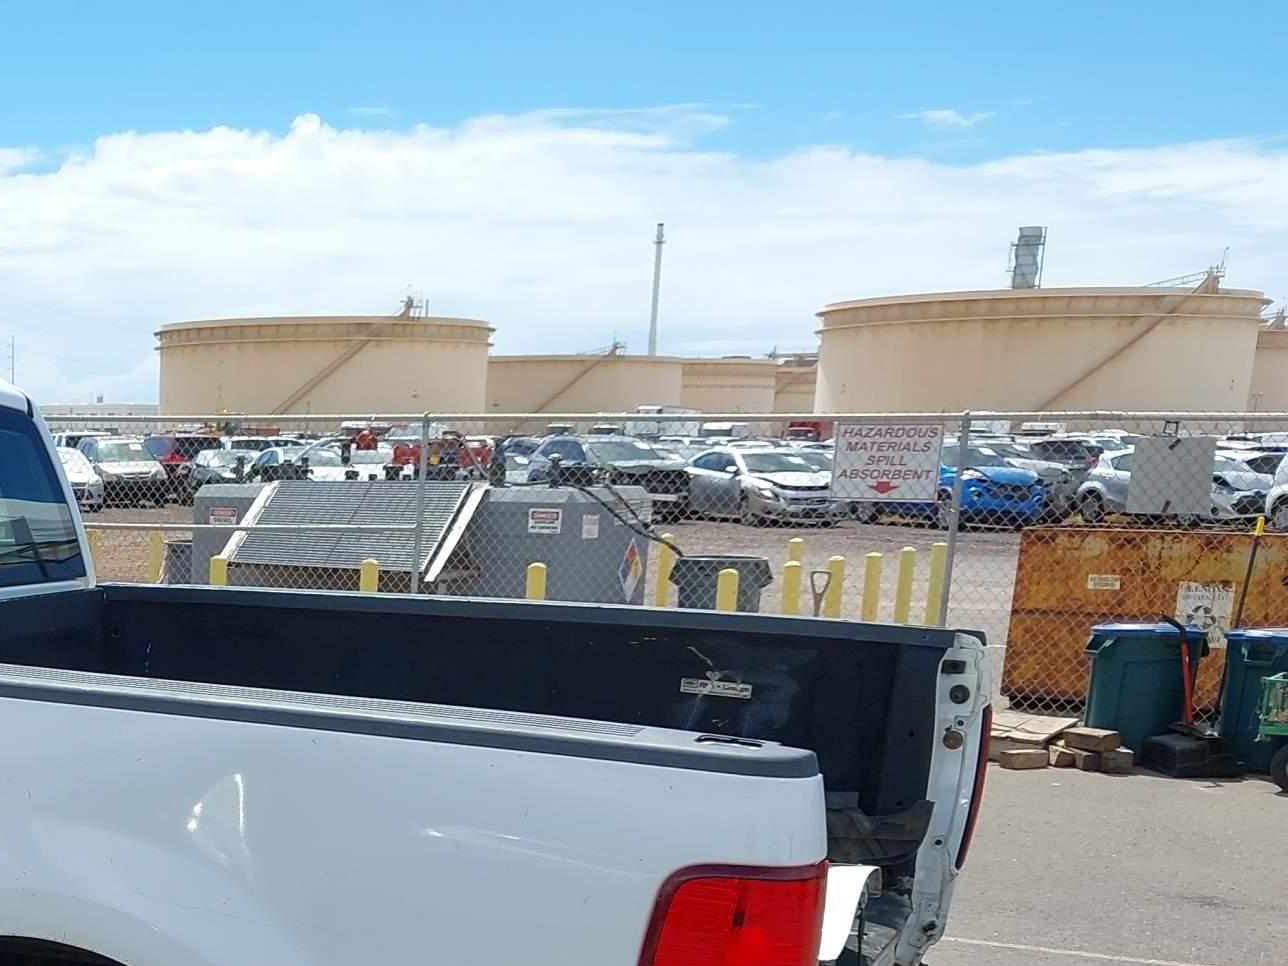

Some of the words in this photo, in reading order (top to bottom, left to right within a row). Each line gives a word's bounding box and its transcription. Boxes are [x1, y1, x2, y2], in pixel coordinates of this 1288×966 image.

[842, 427, 939, 439] HAZARDOUS
[845, 441, 932, 453] MATERIALS
[865, 455, 907, 466] SPILL
[838, 468, 933, 480] ABSORBENT
